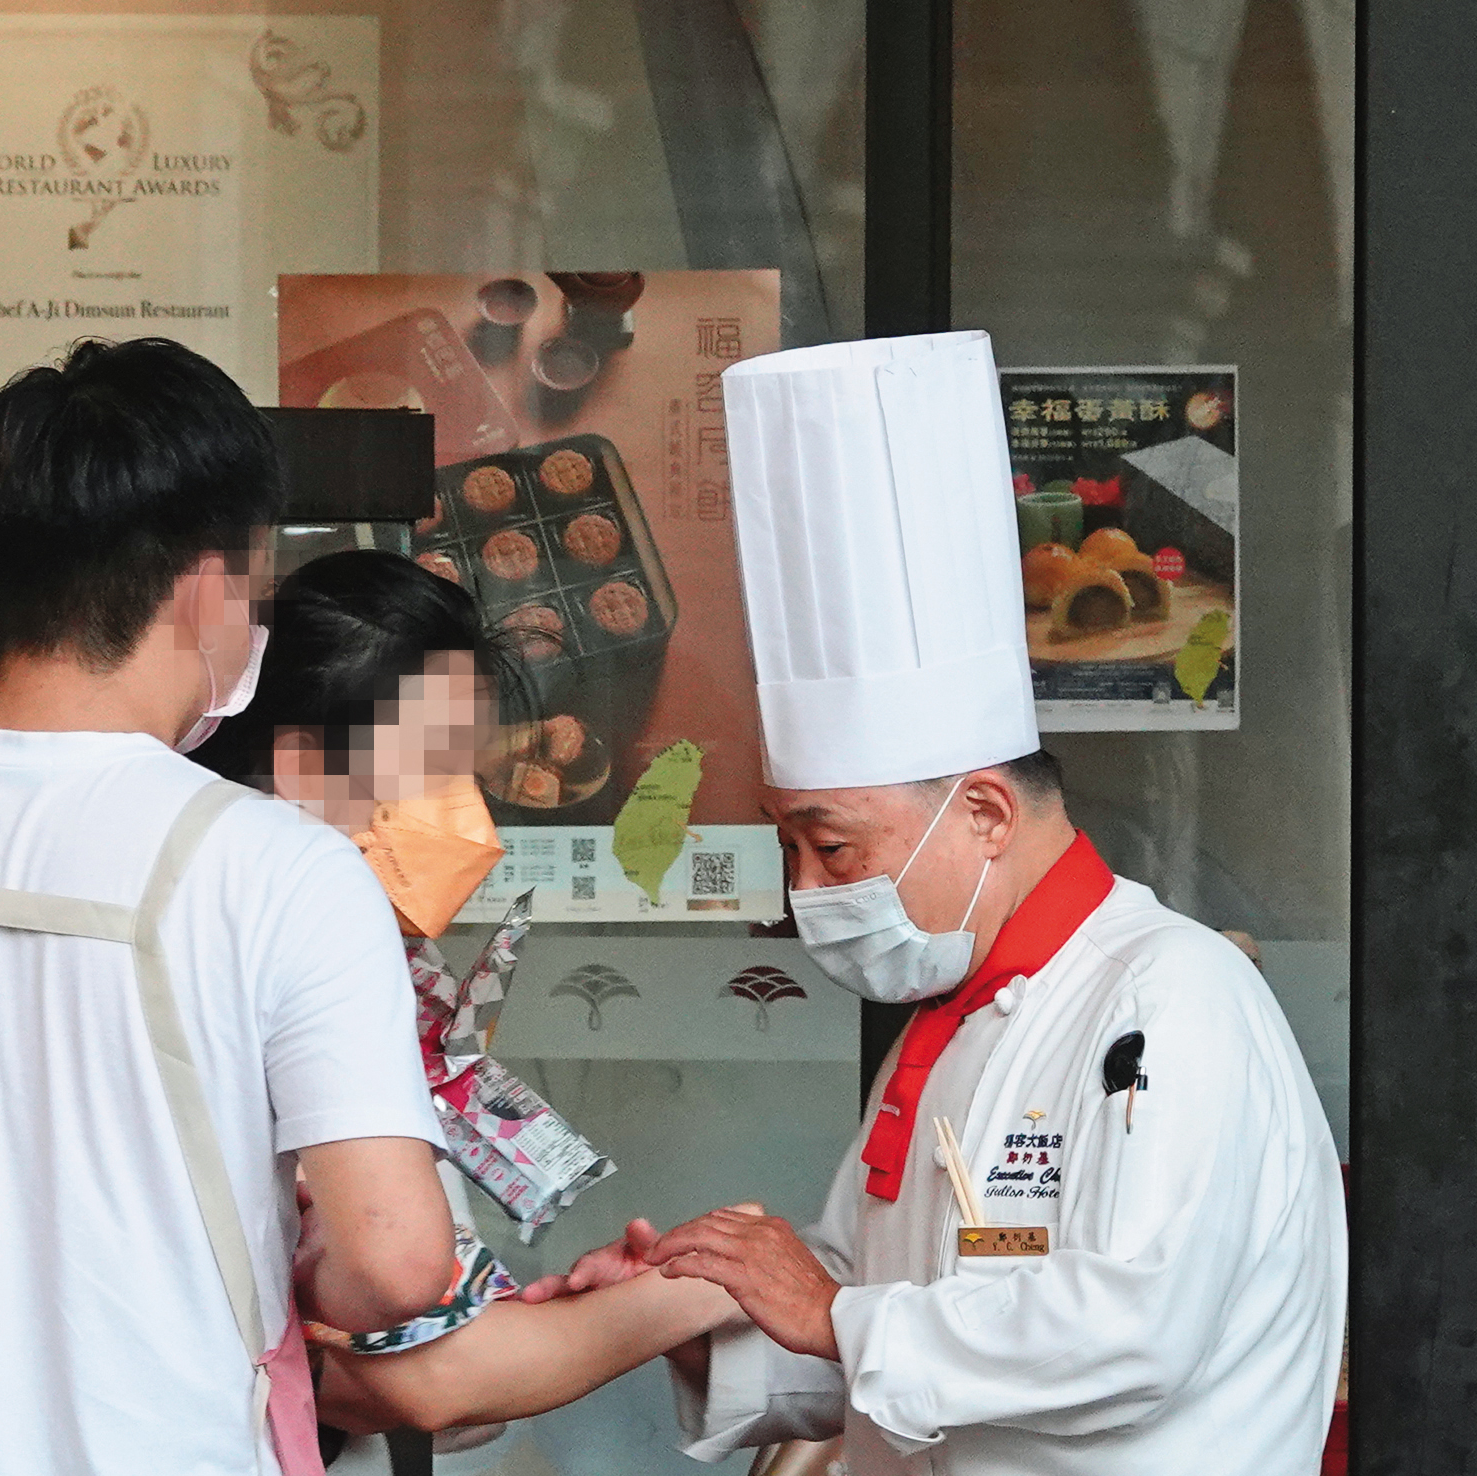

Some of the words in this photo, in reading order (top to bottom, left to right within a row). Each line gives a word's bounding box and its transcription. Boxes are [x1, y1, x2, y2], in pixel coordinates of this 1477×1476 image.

[153, 151, 232, 172] LUXURY
[132, 178, 221, 196] AWARDS
[26, 300, 60, 322] A-Ji
[64, 300, 136, 319] Dimsum
[140, 300, 230, 319] Restaurant
